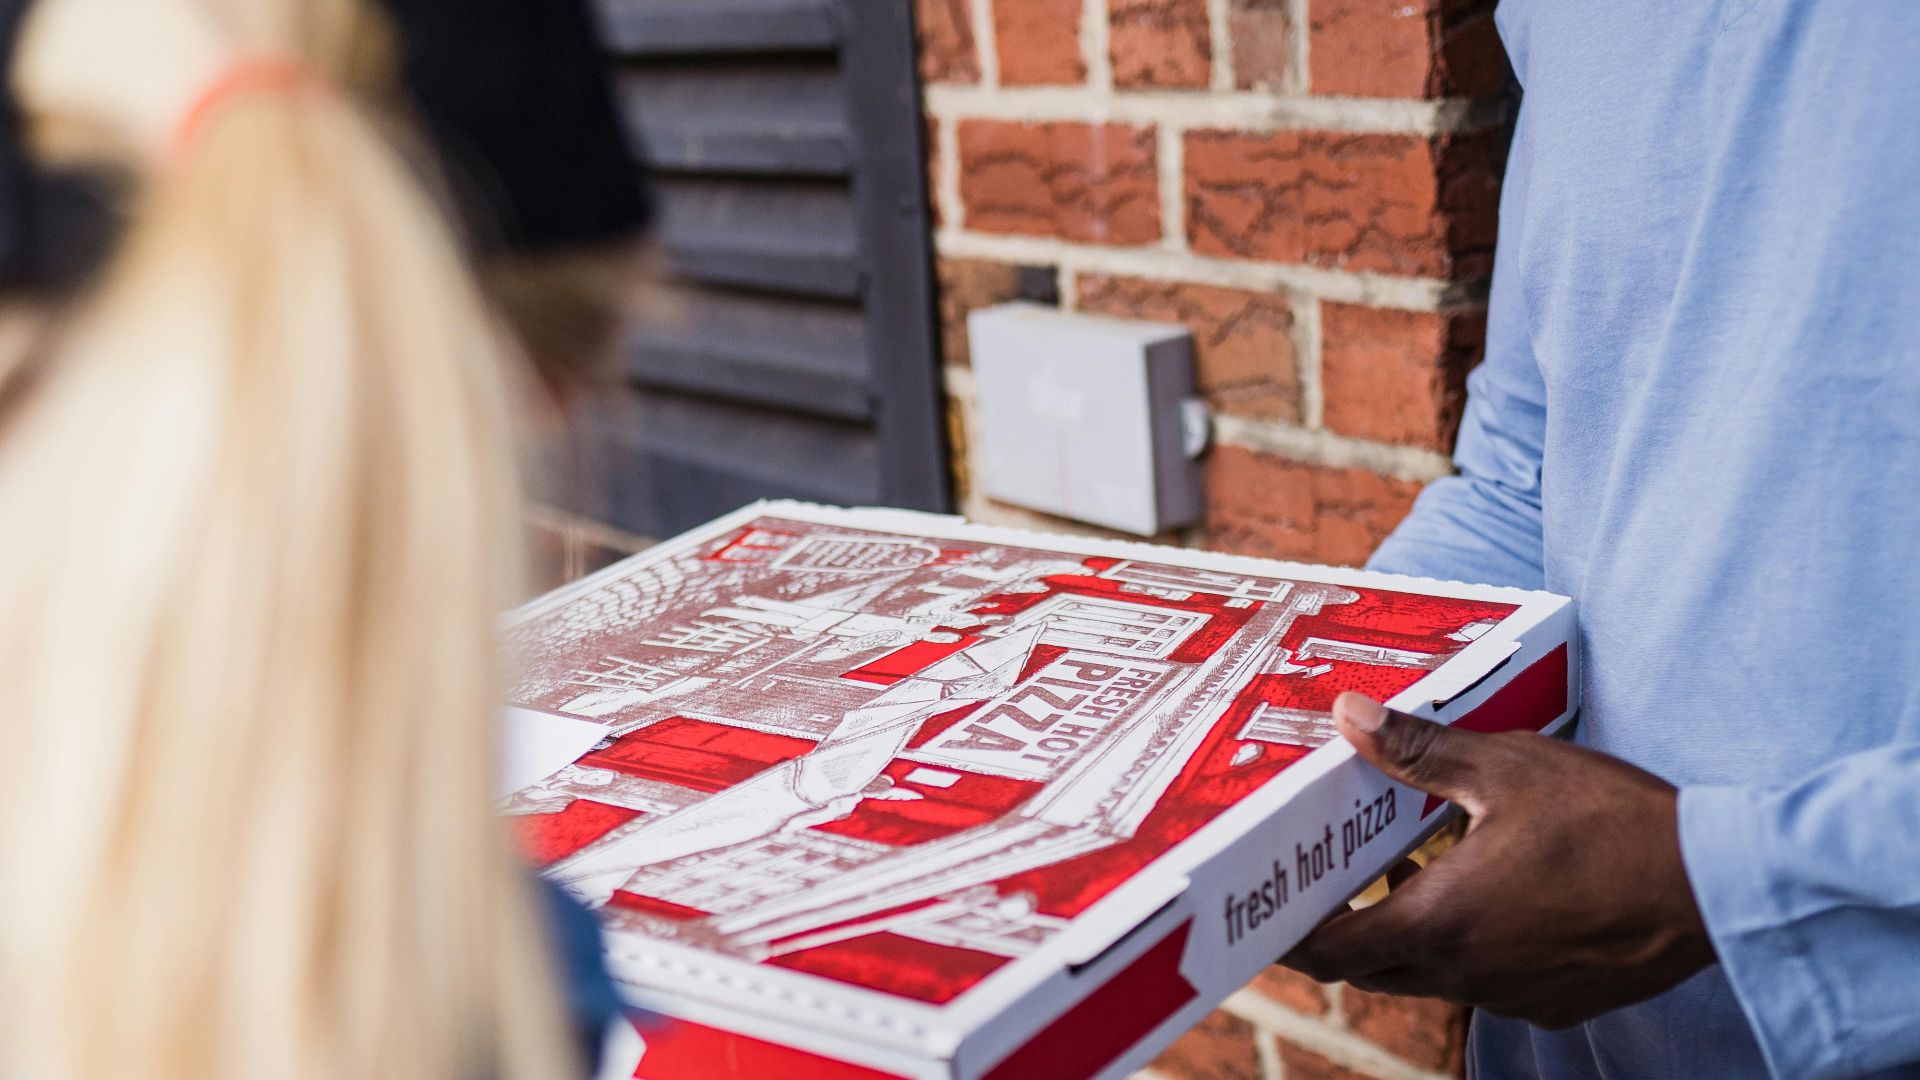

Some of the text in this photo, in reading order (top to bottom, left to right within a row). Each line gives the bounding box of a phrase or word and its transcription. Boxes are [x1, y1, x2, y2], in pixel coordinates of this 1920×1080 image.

[938, 659, 1123, 752] PIZZA
[1022, 668, 1162, 769] FRESH HOT
[1224, 787, 1397, 946] fresh hot pizza
